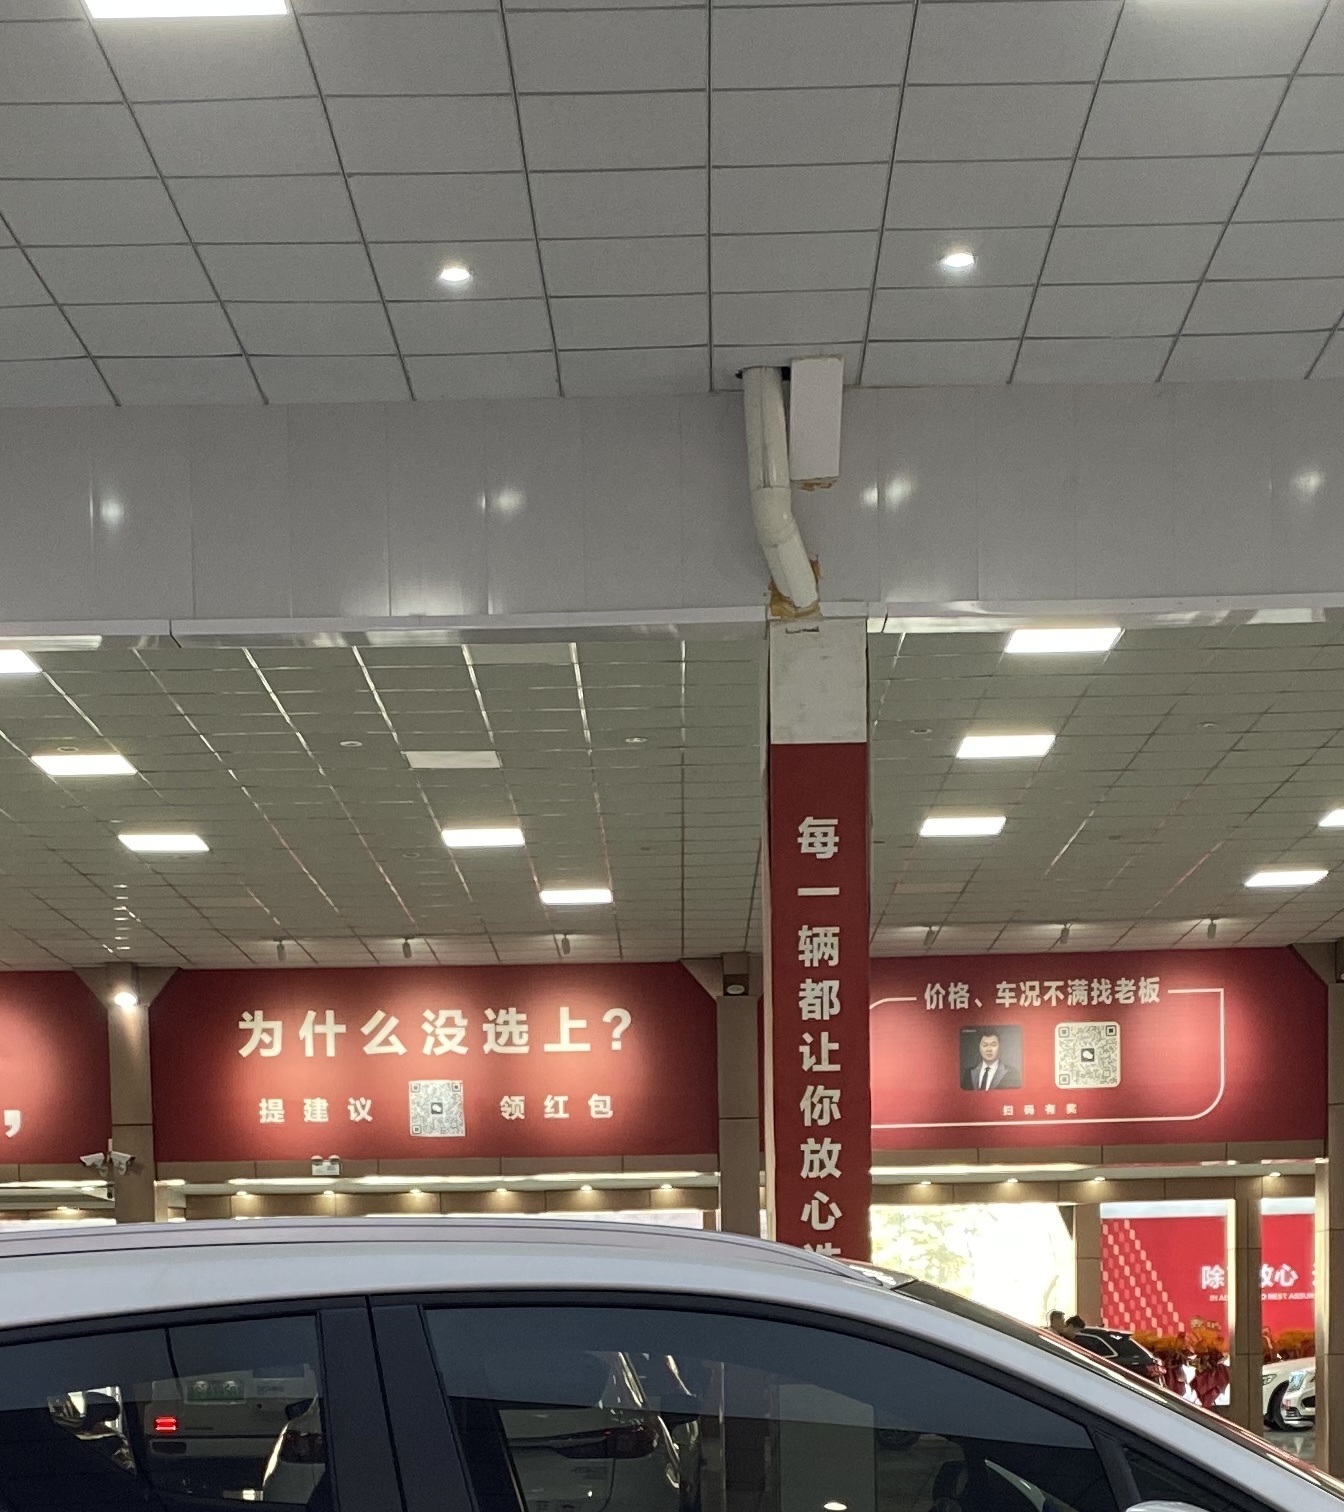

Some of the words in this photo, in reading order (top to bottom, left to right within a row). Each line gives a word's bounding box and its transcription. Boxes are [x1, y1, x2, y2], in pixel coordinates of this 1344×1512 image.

[923, 976, 1161, 1011] 价格、车况不满找老板
[238, 1006, 633, 1059] 为什么没选上？
[258, 1096, 375, 1125] 提建议
[499, 1093, 614, 1121] 领红包
